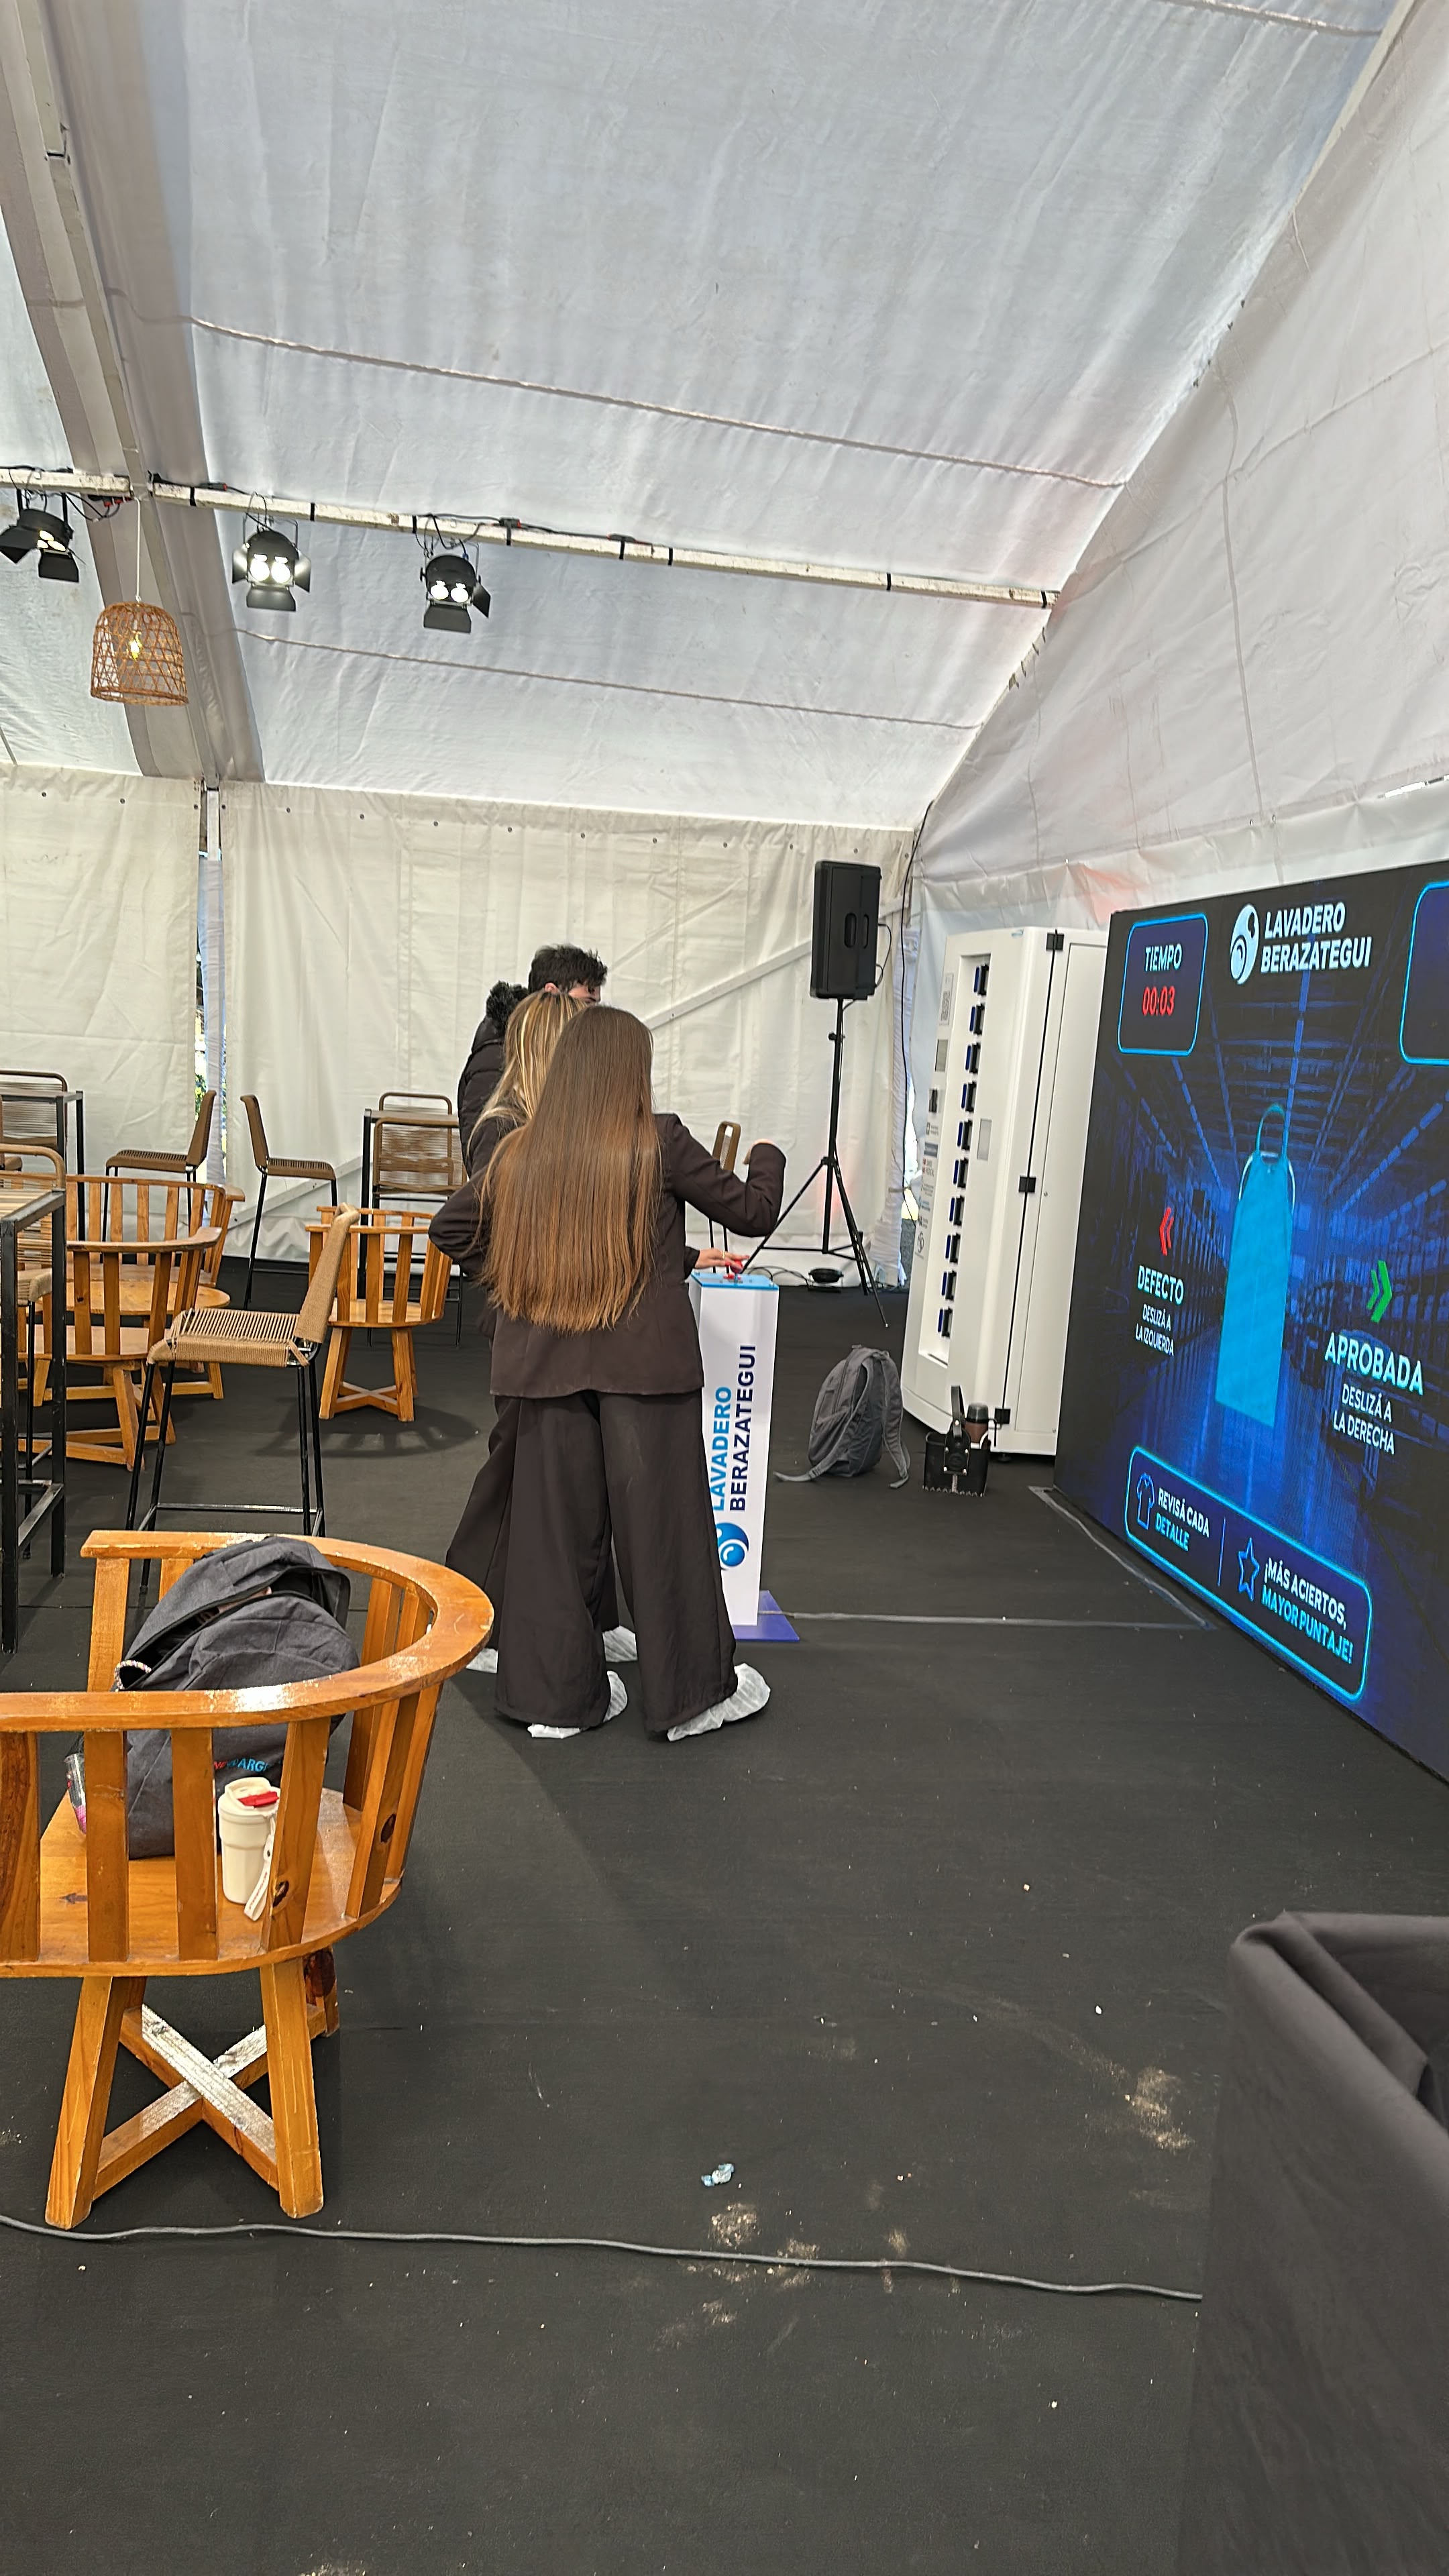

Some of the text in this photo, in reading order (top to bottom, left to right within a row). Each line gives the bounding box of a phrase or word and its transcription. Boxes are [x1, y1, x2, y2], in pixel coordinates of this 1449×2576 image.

[1265, 902, 1346, 938] LAVADERO
[1144, 943, 1182, 971] TIEMPO
[1260, 936, 1372, 973] BERAZATEGUI
[1142, 985, 1175, 1016] 00:03
[1137, 1265, 1183, 1305] DEFECTO
[1142, 1304, 1171, 1331] DESLIZÁ A
[1135, 1323, 1174, 1356] LA IZQUIERDA
[1324, 1332, 1423, 1395] APROBADA
[1342, 1383, 1392, 1423] DESLIZÁ A
[730, 1345, 757, 1511] BERAZATEGUI
[1334, 1409, 1395, 1454] LA DERECHA
[710, 1386, 732, 1511] LAVADERO
[1155, 1512, 1189, 1551] DETALLE
[1158, 1487, 1210, 1538] REVISÁ CADA
[1265, 1558, 1347, 1630] ¡MÁS ACIERTOS,
[1261, 1585, 1354, 1664] MAYOR PUNTAJE!
